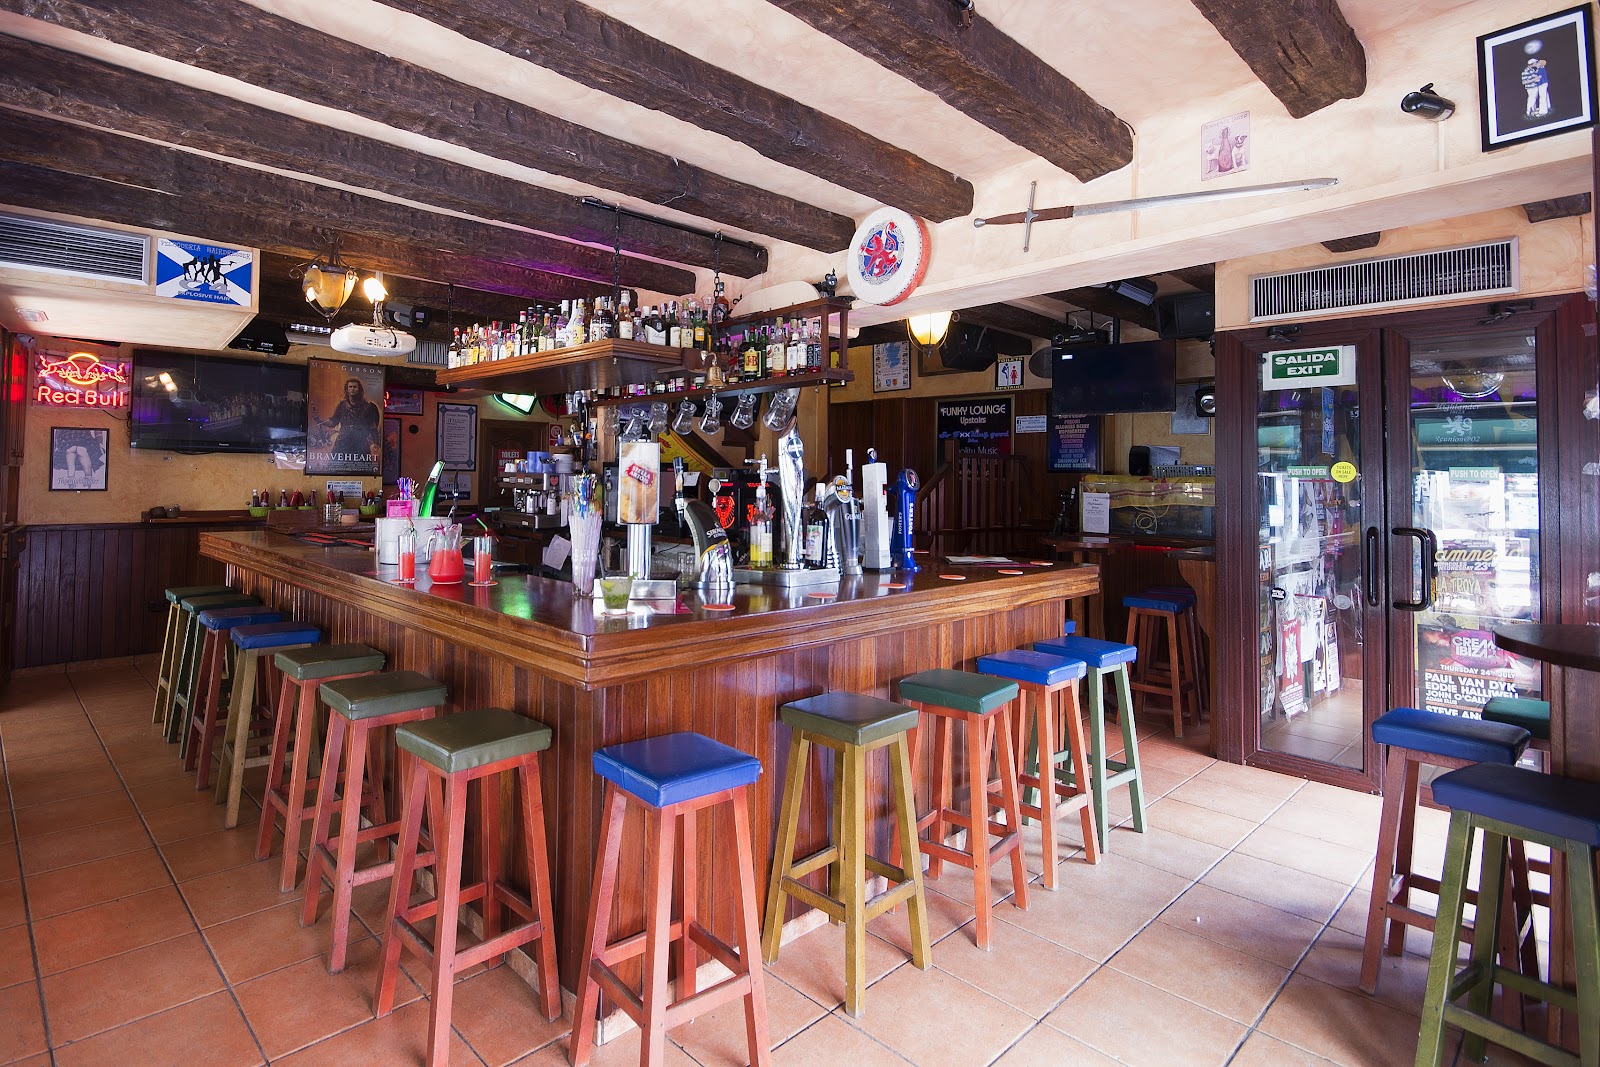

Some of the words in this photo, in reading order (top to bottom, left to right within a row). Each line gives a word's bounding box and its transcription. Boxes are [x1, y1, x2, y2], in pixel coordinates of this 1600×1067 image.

[1275, 352, 1336, 365] SALIDA
[311, 362, 332, 370] MEL
[341, 365, 382, 374] GIBSON
[1287, 365, 1323, 376] EXIT
[37, 385, 80, 405] Red
[84, 389, 124, 407] Bull
[941, 406, 968, 416] FUNKY
[969, 404, 1006, 415] LOUNGE
[960, 417, 987, 426] Upstairs
[501, 451, 520, 459] TOILETS
[977, 446, 998, 455] Music
[309, 452, 379, 462] BRAVEHEART
[632, 465, 651, 480] STELLA
[1288, 468, 1302, 476] PUSH
[1303, 468, 1311, 476] TO
[1311, 468, 1327, 476] OPEN
[1450, 469, 1469, 478] PUSH
[1469, 469, 1479, 478] TO
[1481, 469, 1499, 479] OPEN
[1435, 576, 1447, 593] LA
[1450, 577, 1482, 595] TROYA
[1440, 664, 1479, 675] THURSDAY
[1498, 670, 1516, 679] JULY
[1425, 672, 1455, 685] PAUL
[1458, 676, 1485, 689] VAN
[1489, 680, 1517, 693] DYK
[1425, 681, 1457, 693] EDDIE
[1425, 689, 1452, 700] JOHN
[1425, 705, 1459, 717] STEVE
